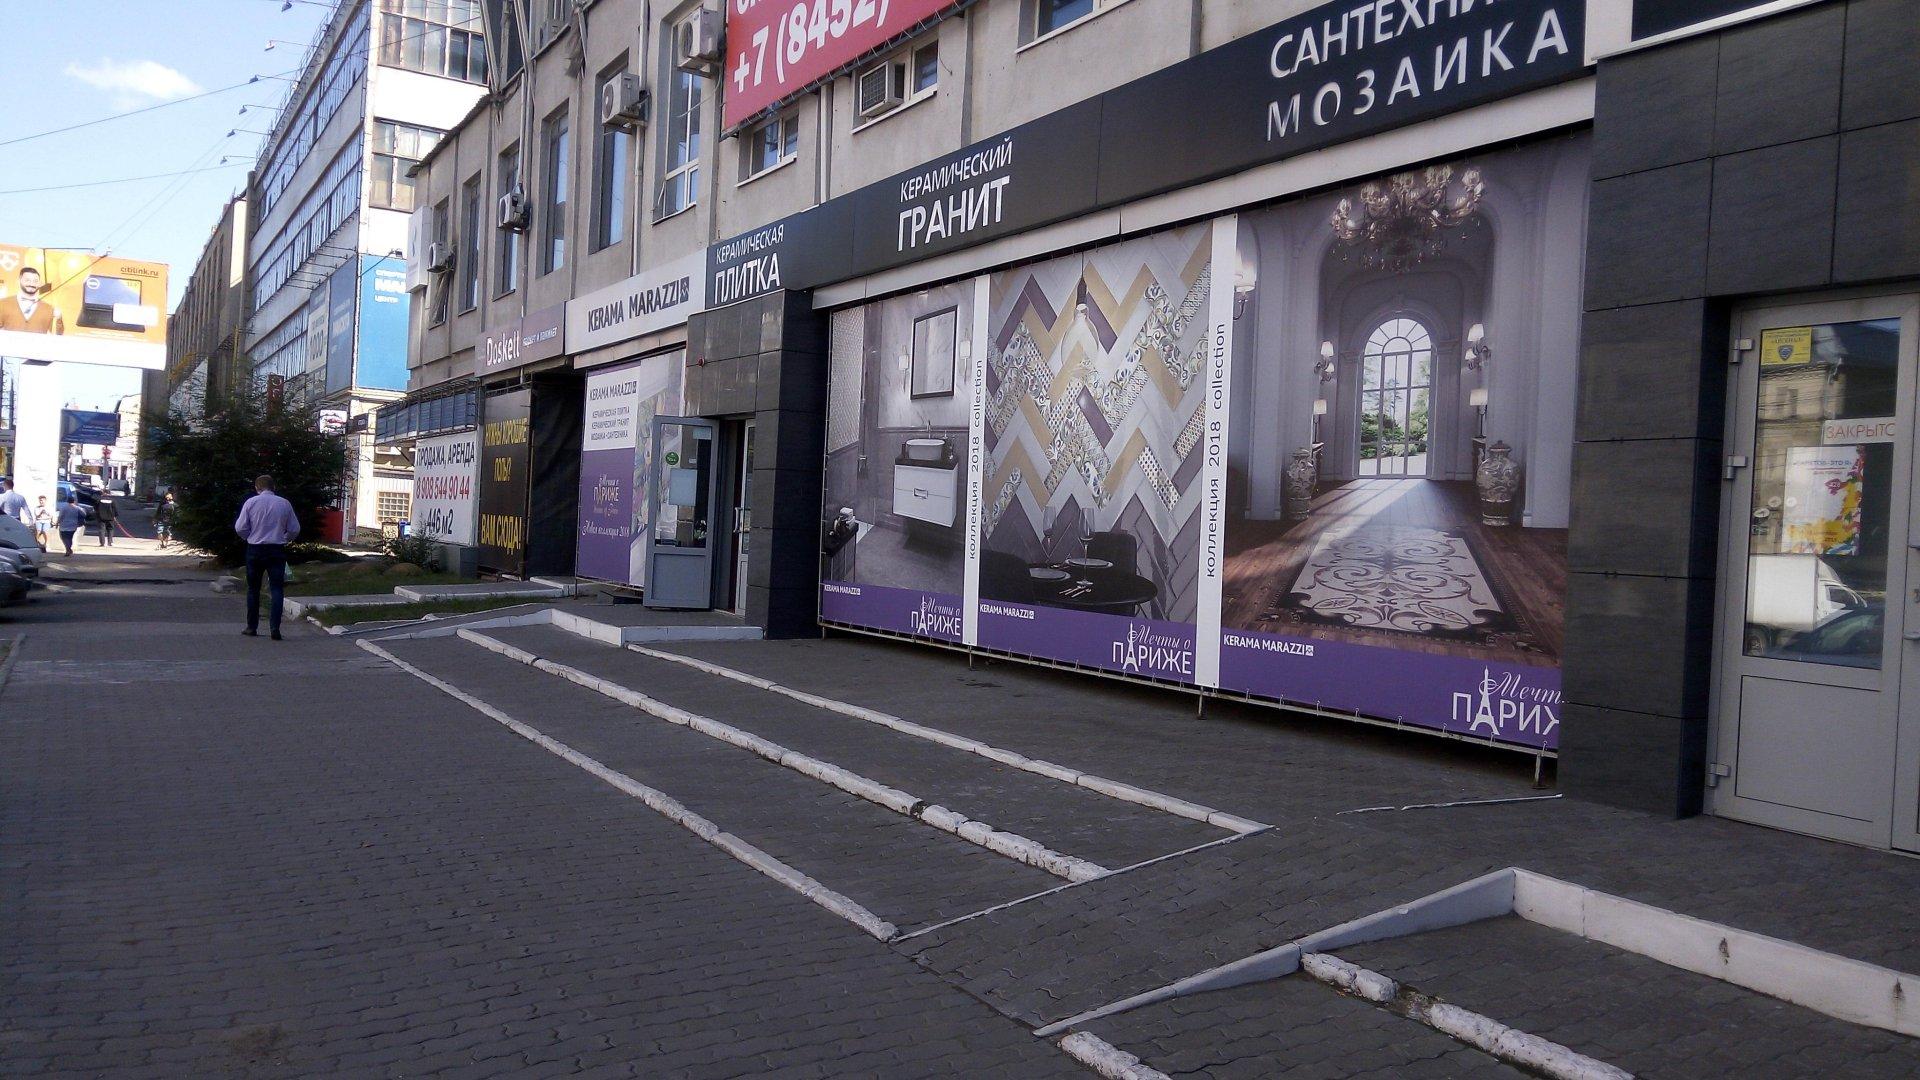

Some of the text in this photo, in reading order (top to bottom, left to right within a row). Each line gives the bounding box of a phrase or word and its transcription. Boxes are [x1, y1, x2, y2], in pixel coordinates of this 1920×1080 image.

[734, 26, 769, 93] +7
[1267, 8, 1569, 141] МОЗАИКА
[900, 137, 1014, 202] КЕРАМИЧЕСКИЙ
[898, 176, 1010, 251] ГРАНИТ
[716, 223, 784, 264] КЕРАМИЧЕСКАЯ
[714, 252, 780, 305] ПЛИТКА
[588, 280, 680, 333] KERAMA MARAZZI
[590, 381, 632, 401] KERAMA MARAZZI
[416, 441, 475, 469] ПРОДАЖА, АРЕНДА
[970, 360, 983, 559] коллекция 2018 collection
[1207, 324, 1225, 577] коллекция 2018 collection
[416, 478, 421, 500] 8
[459, 476, 470, 500] 44
[481, 513, 522, 555] ВАМ СЮДА!
[824, 585, 857, 595] KERAMA MARAZZI
[911, 609, 961, 636] ПАРИЖЕ
[979, 603, 1029, 619] KERAMA MARAZZI
[1127, 625, 1181, 647] Мечты
[1223, 634, 1305, 656] KERAMA MARAZZI
[1112, 639, 1192, 675] ПАРИЖЕ
[1479, 671, 1562, 704] Мечт
